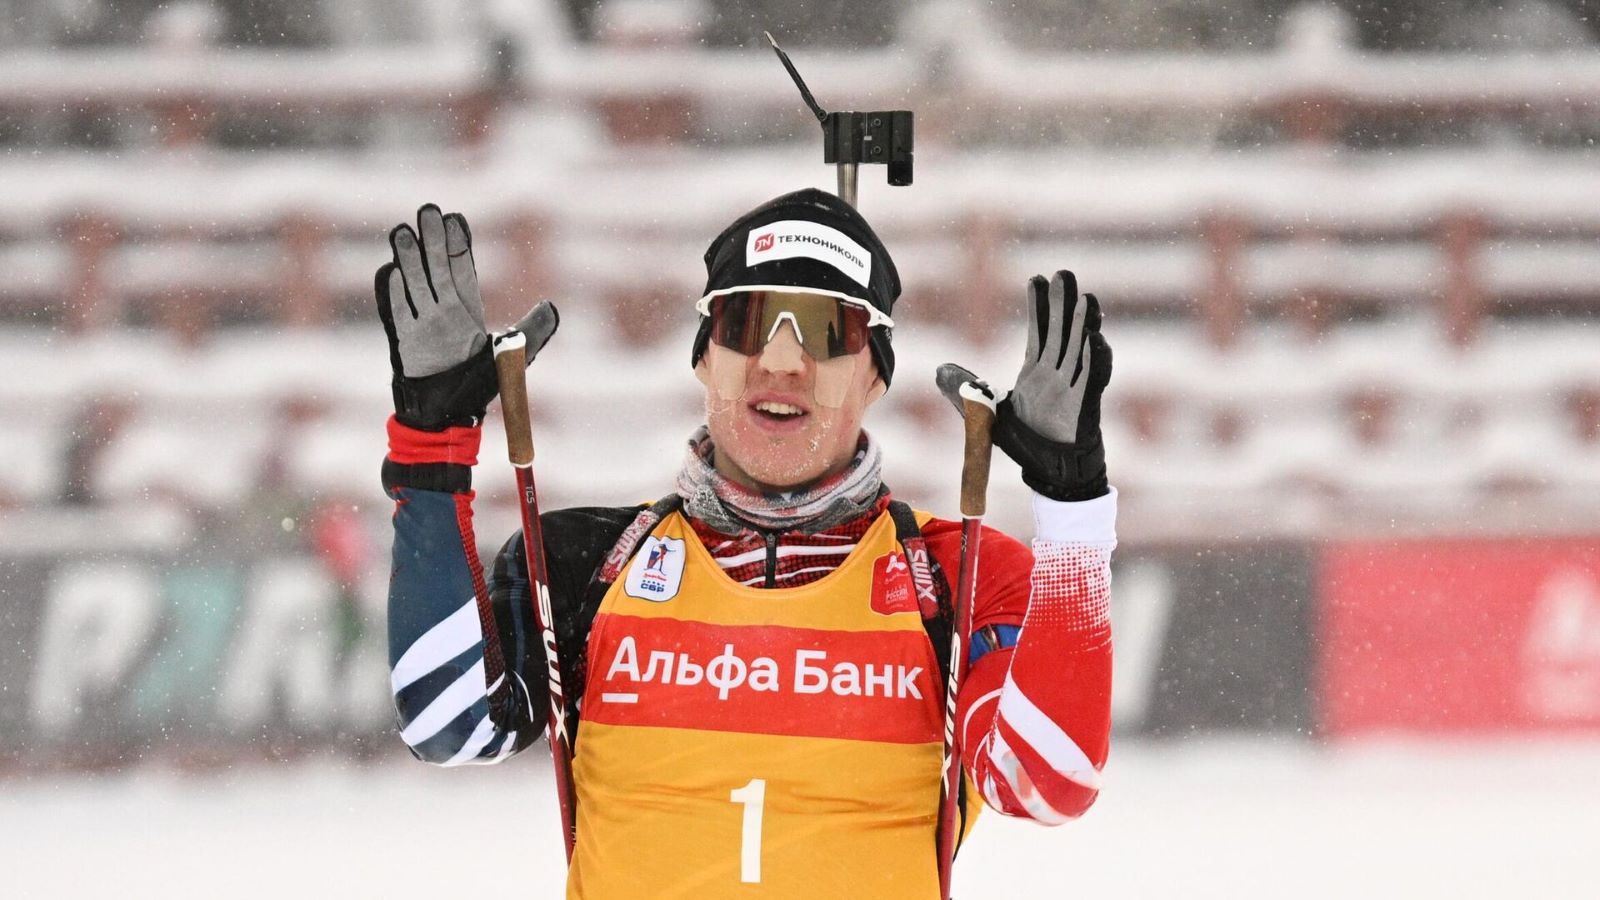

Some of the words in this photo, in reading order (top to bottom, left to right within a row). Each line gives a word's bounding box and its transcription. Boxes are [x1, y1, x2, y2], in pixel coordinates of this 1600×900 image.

[778, 235, 864, 268] ТЕХНОНИКОЛЬ
[535, 580, 570, 749] SWIX
[605, 636, 779, 700] Альфа
[793, 649, 924, 700] Банк
[730, 778, 766, 884] 1
